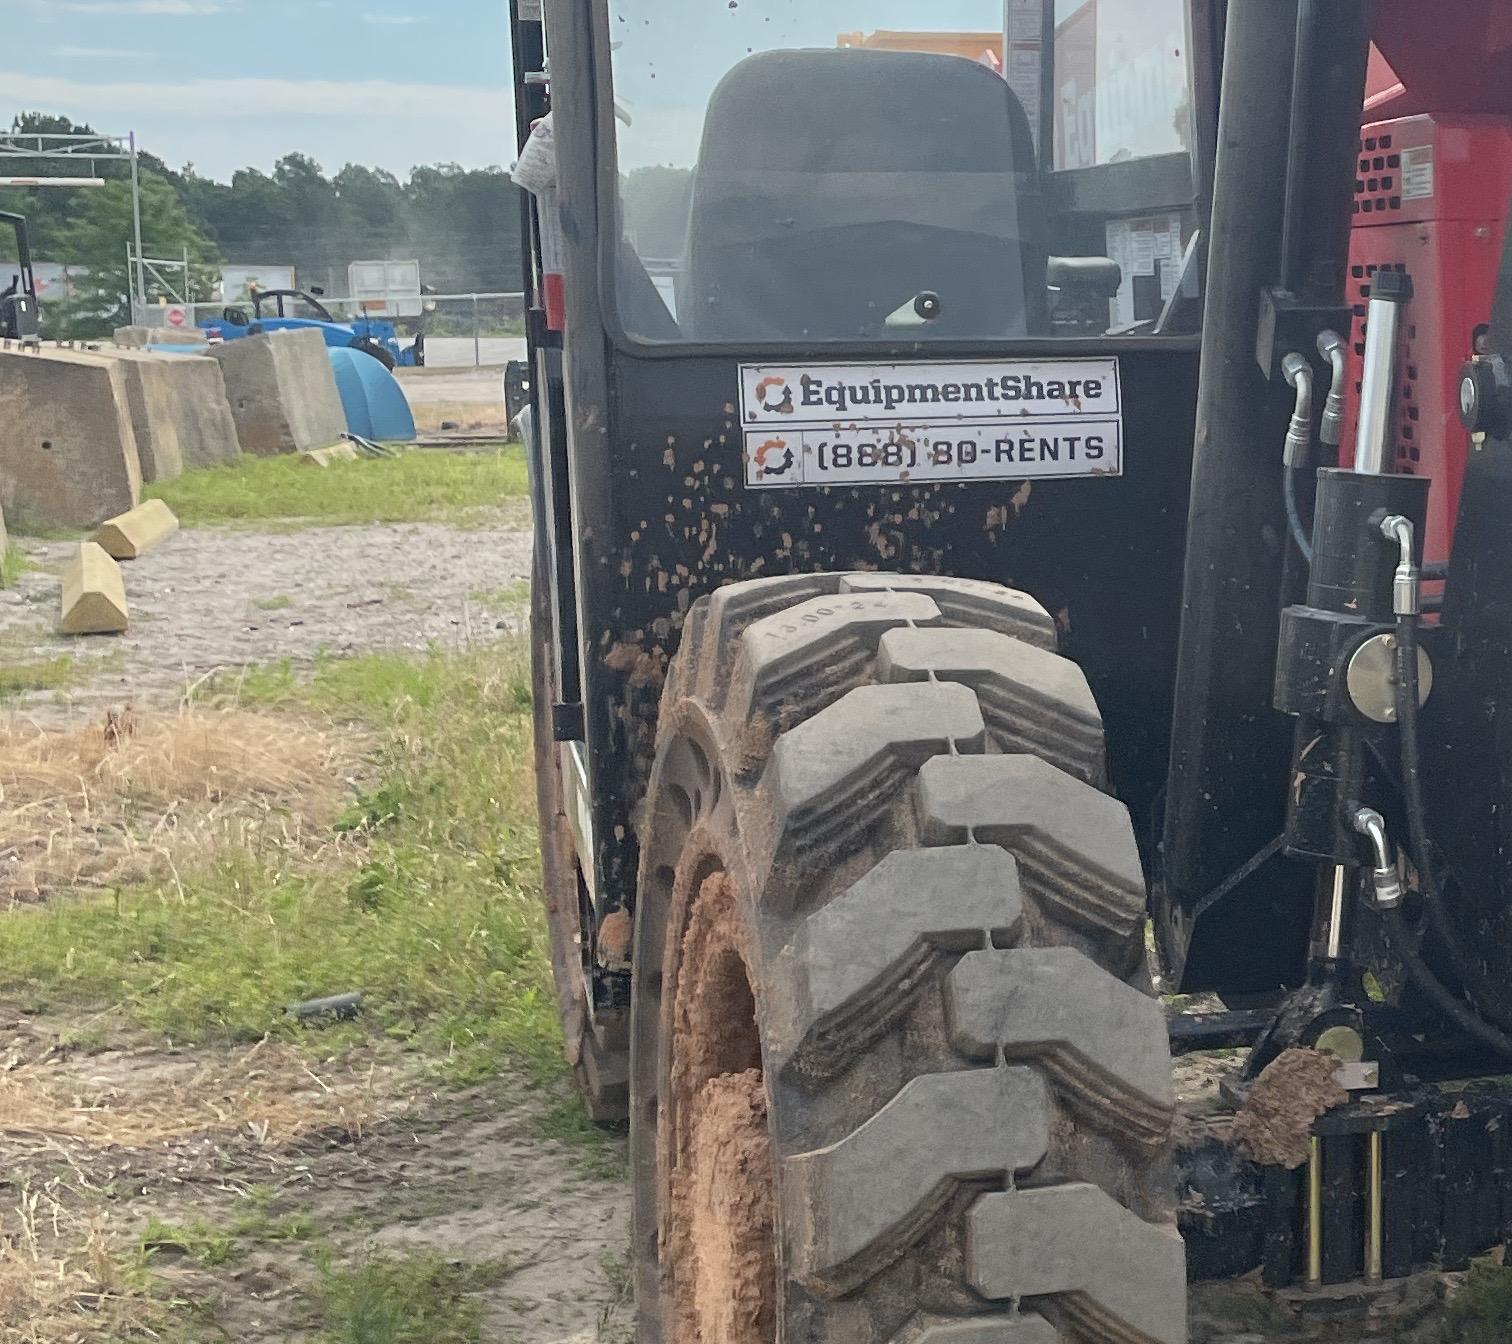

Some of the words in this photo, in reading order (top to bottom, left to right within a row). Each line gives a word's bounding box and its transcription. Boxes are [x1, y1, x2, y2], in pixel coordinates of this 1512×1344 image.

[800, 375, 1102, 412] EquipmentShare
[818, 440, 917, 471] (888)
[932, 436, 1104, 466] 80-RENTS
